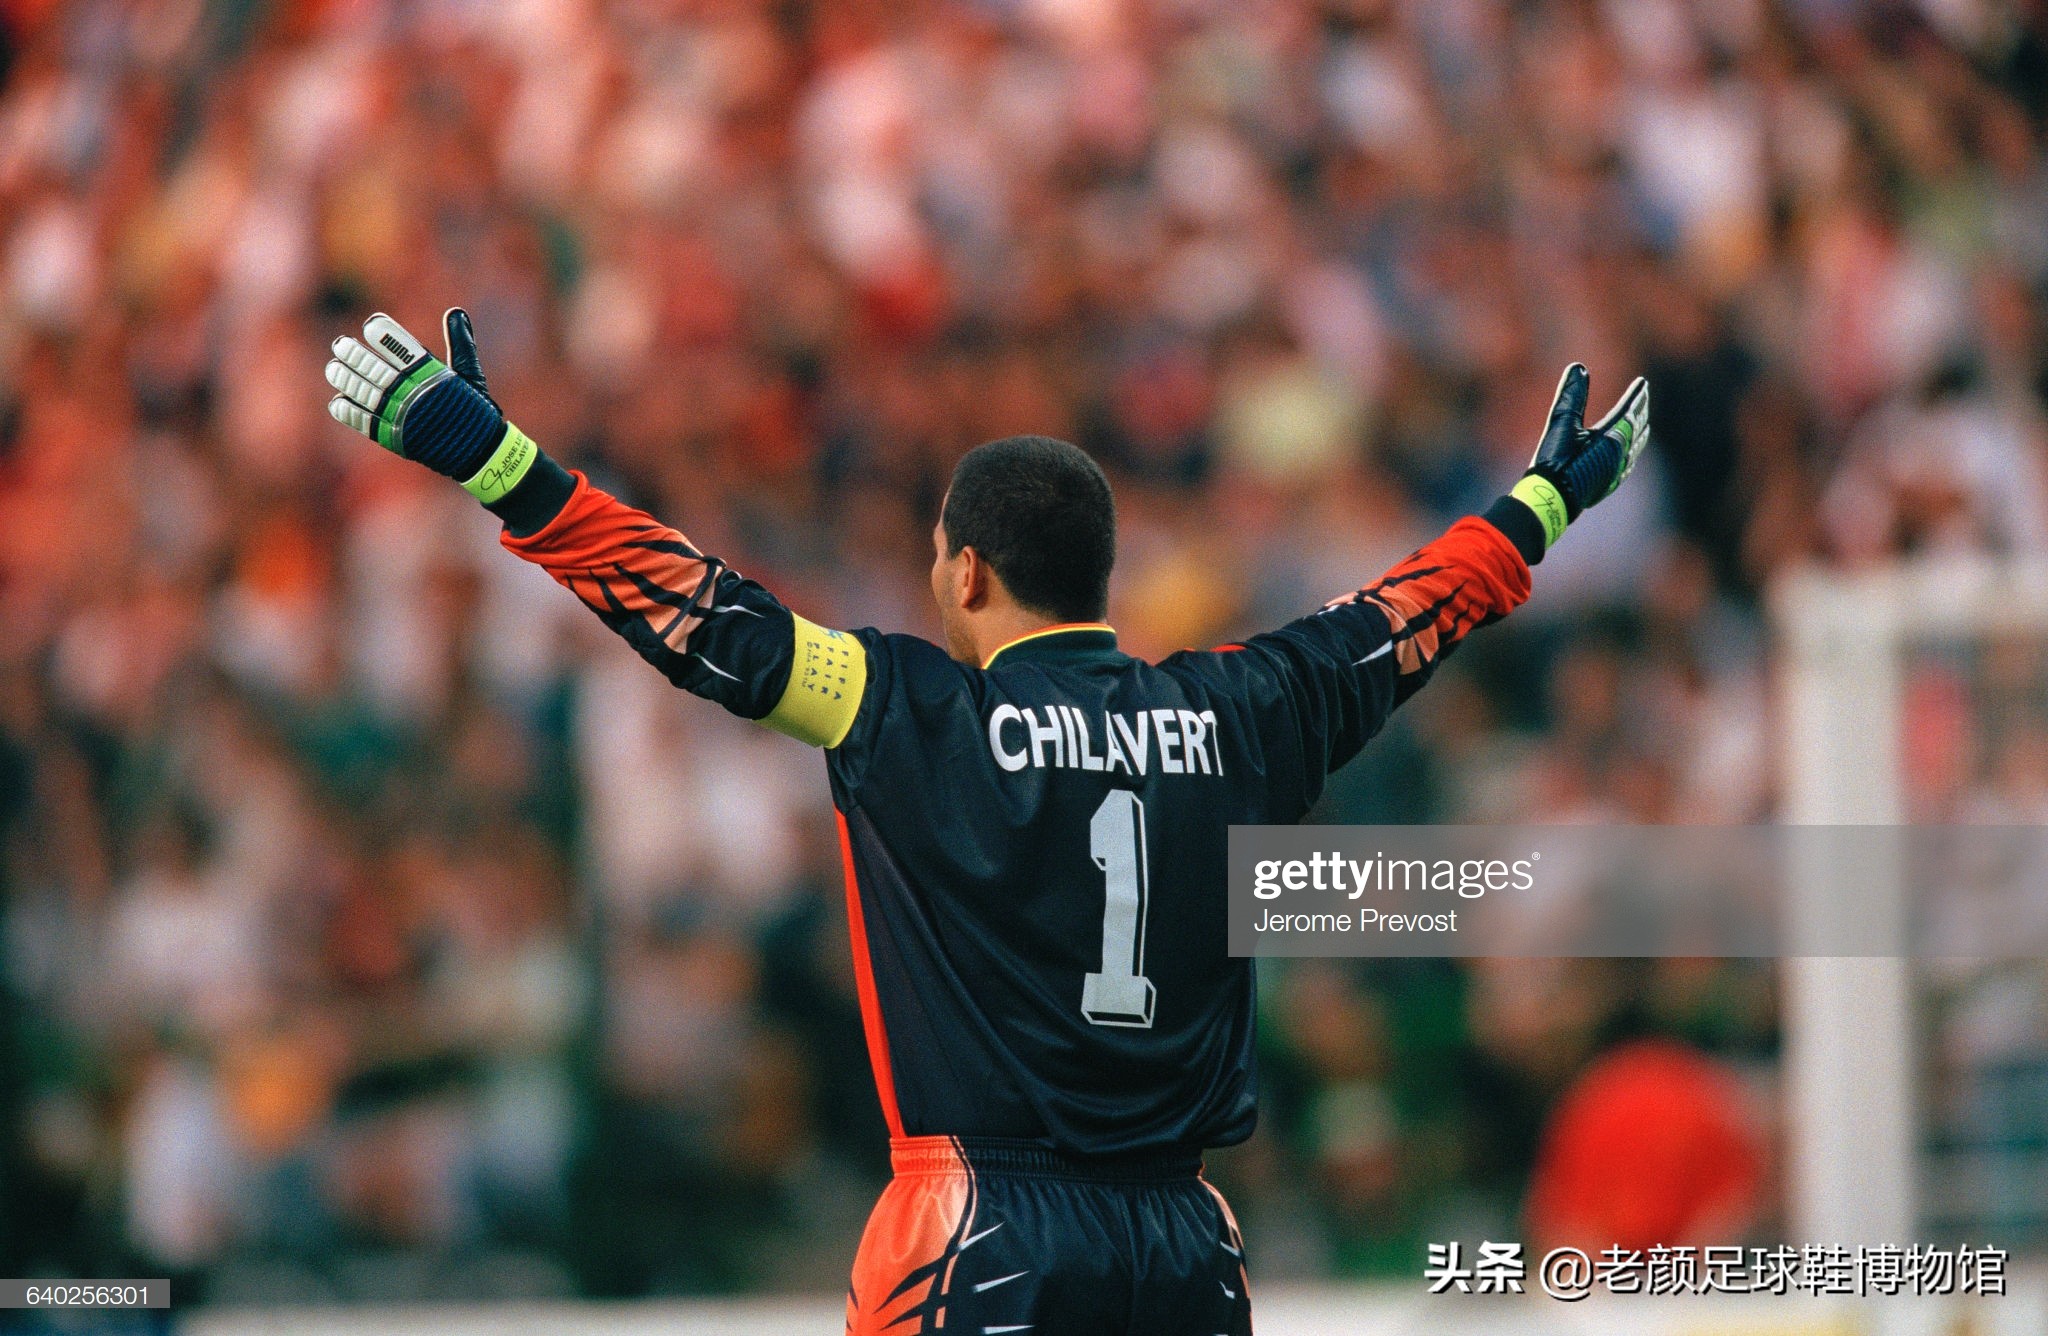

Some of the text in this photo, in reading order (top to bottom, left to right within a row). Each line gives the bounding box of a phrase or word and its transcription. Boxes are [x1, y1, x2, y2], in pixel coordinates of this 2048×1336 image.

[379, 333, 415, 365] PUMA
[502, 446, 518, 468] JOSE
[808, 642, 820, 691] PLAY
[989, 703, 1224, 776] CHILAVERT
[1081, 789, 1157, 1029] 1
